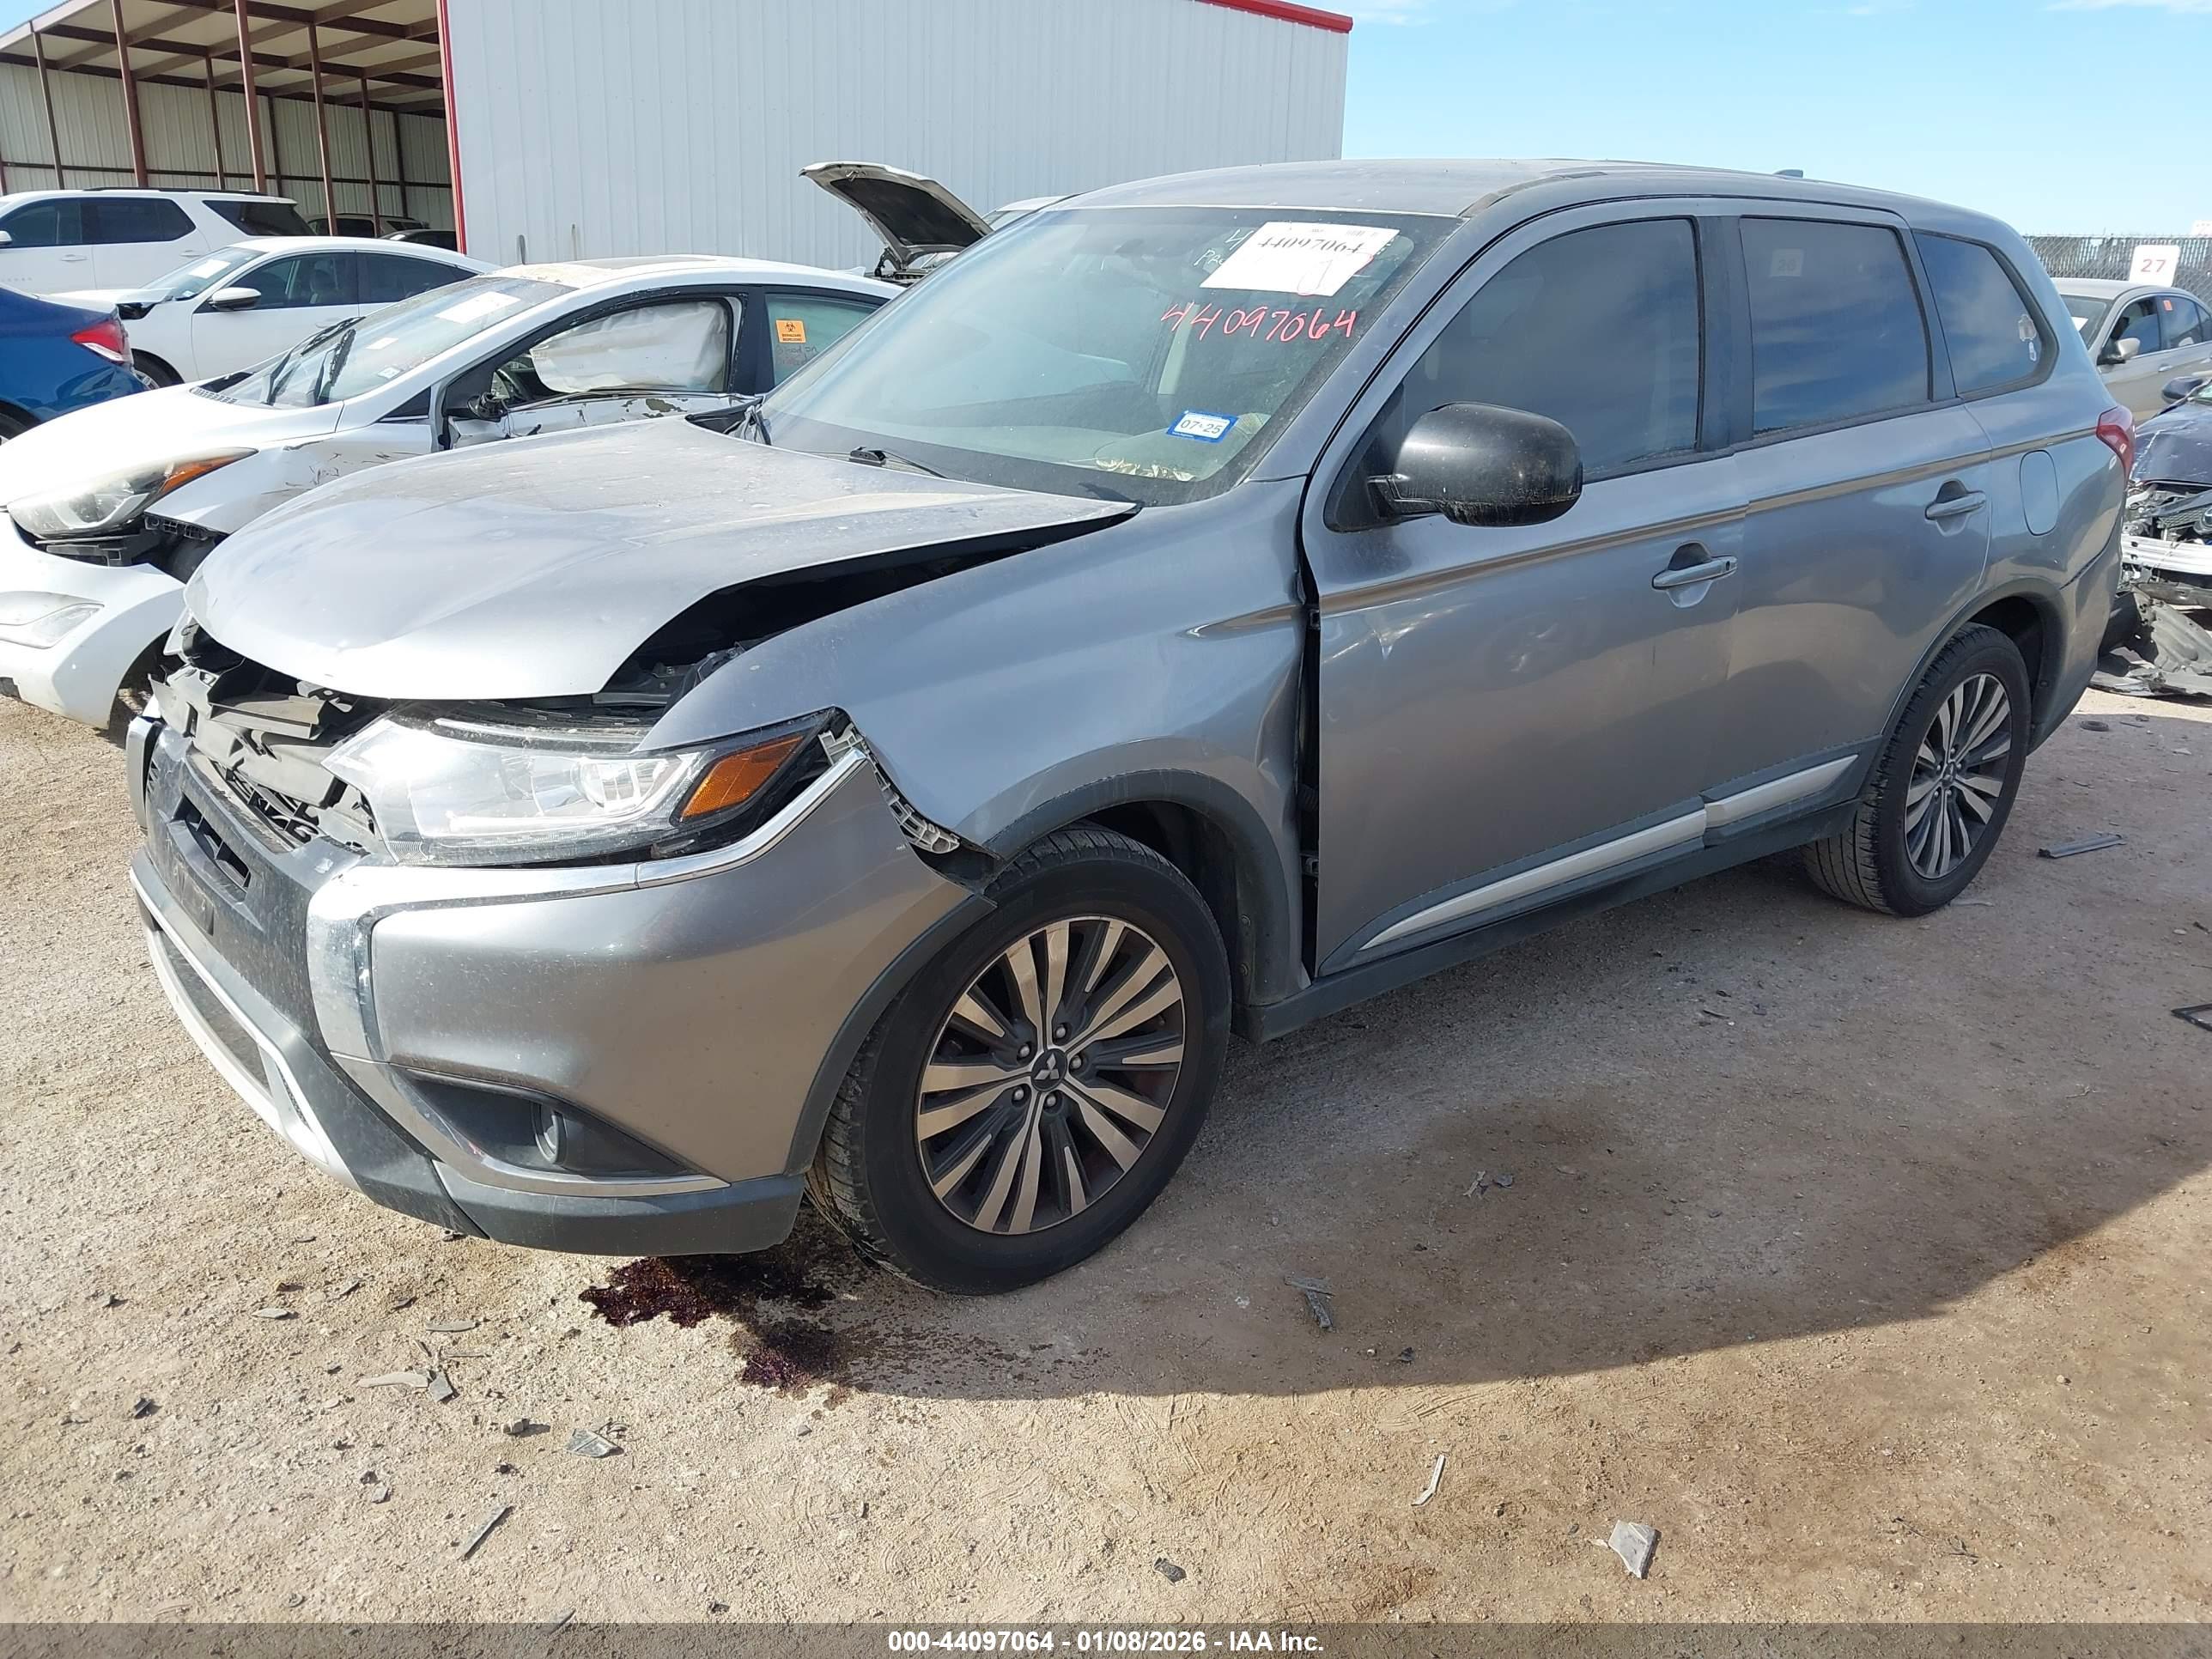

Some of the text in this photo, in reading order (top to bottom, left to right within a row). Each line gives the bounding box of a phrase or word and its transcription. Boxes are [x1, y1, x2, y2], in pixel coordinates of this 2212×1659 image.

[1257, 236, 1365, 254] 44097064
[2141, 258, 2166, 273] 27
[1160, 300, 1357, 342] 44097064
